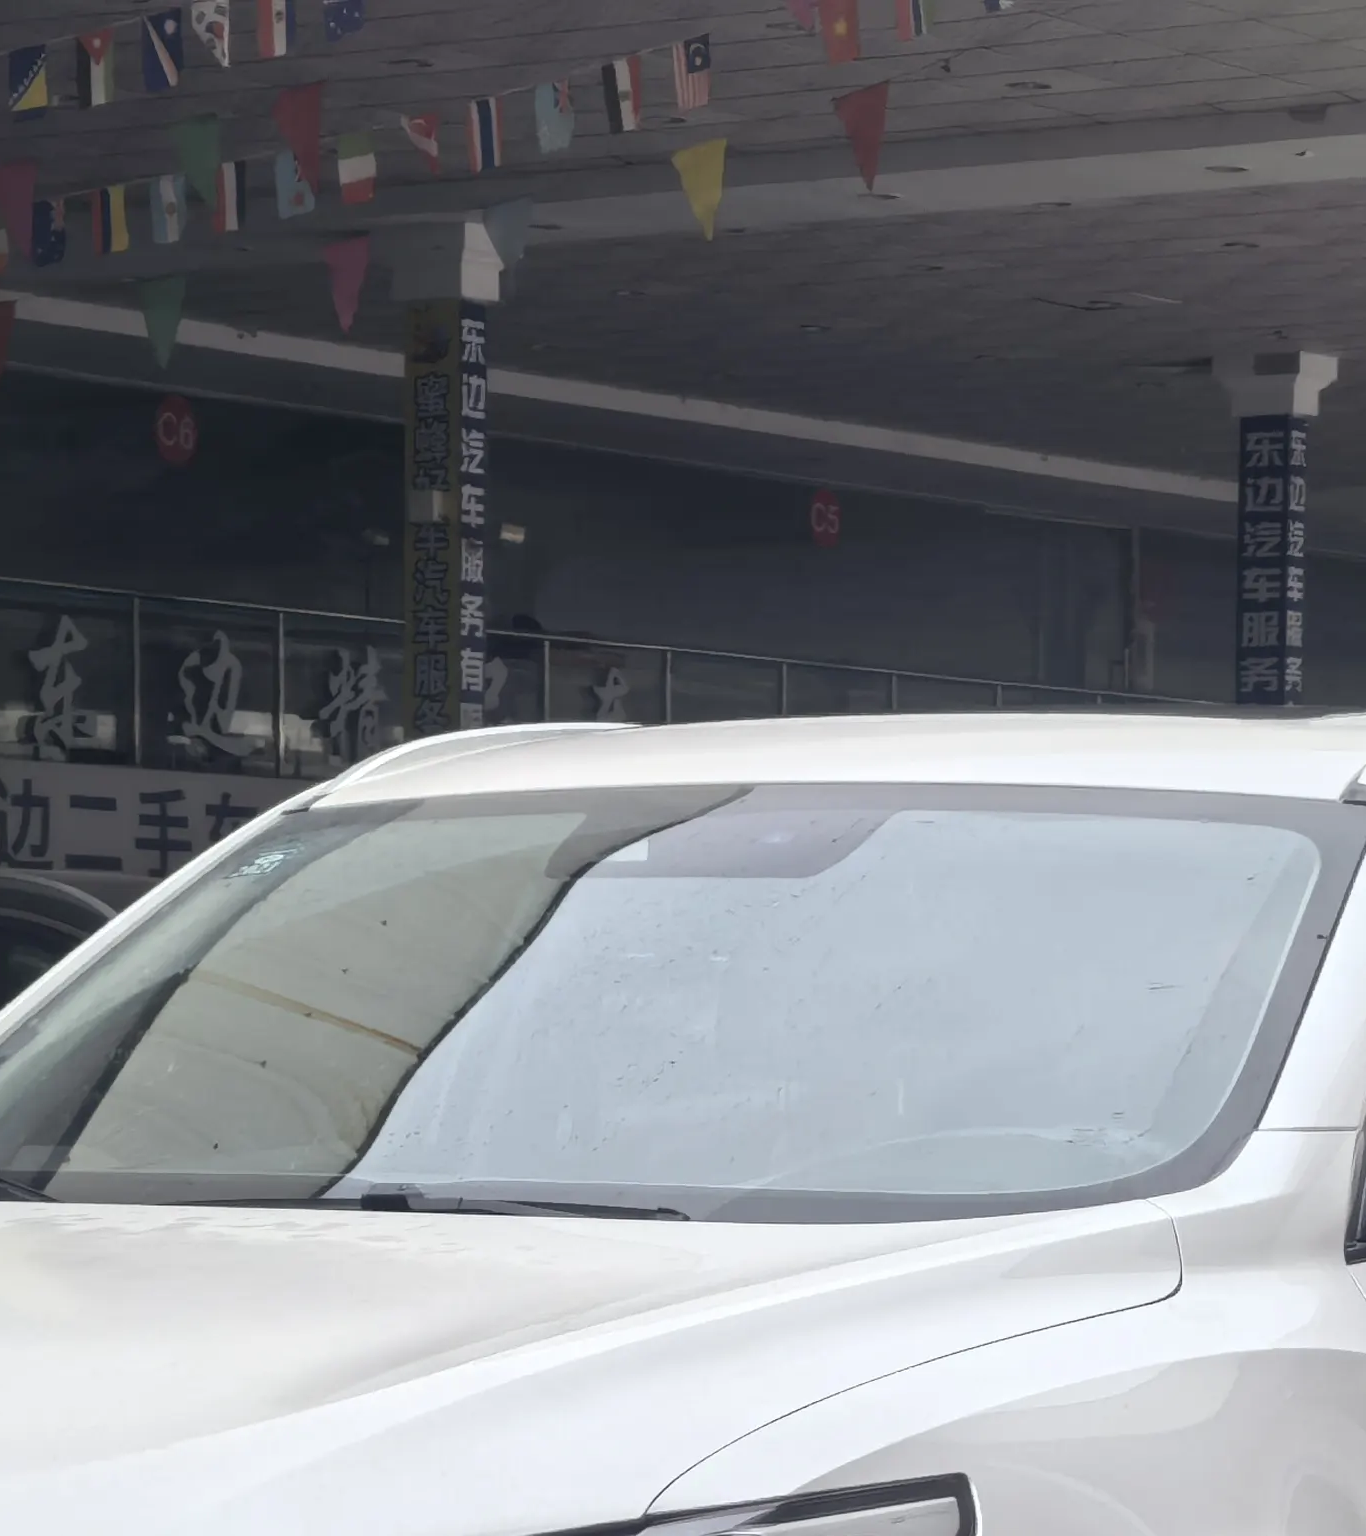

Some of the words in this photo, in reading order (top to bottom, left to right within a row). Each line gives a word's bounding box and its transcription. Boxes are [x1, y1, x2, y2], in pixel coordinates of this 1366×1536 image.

[157, 411, 194, 450] C6
[811, 502, 840, 534] C5
[1239, 430, 1284, 693] 东边汽车服务
